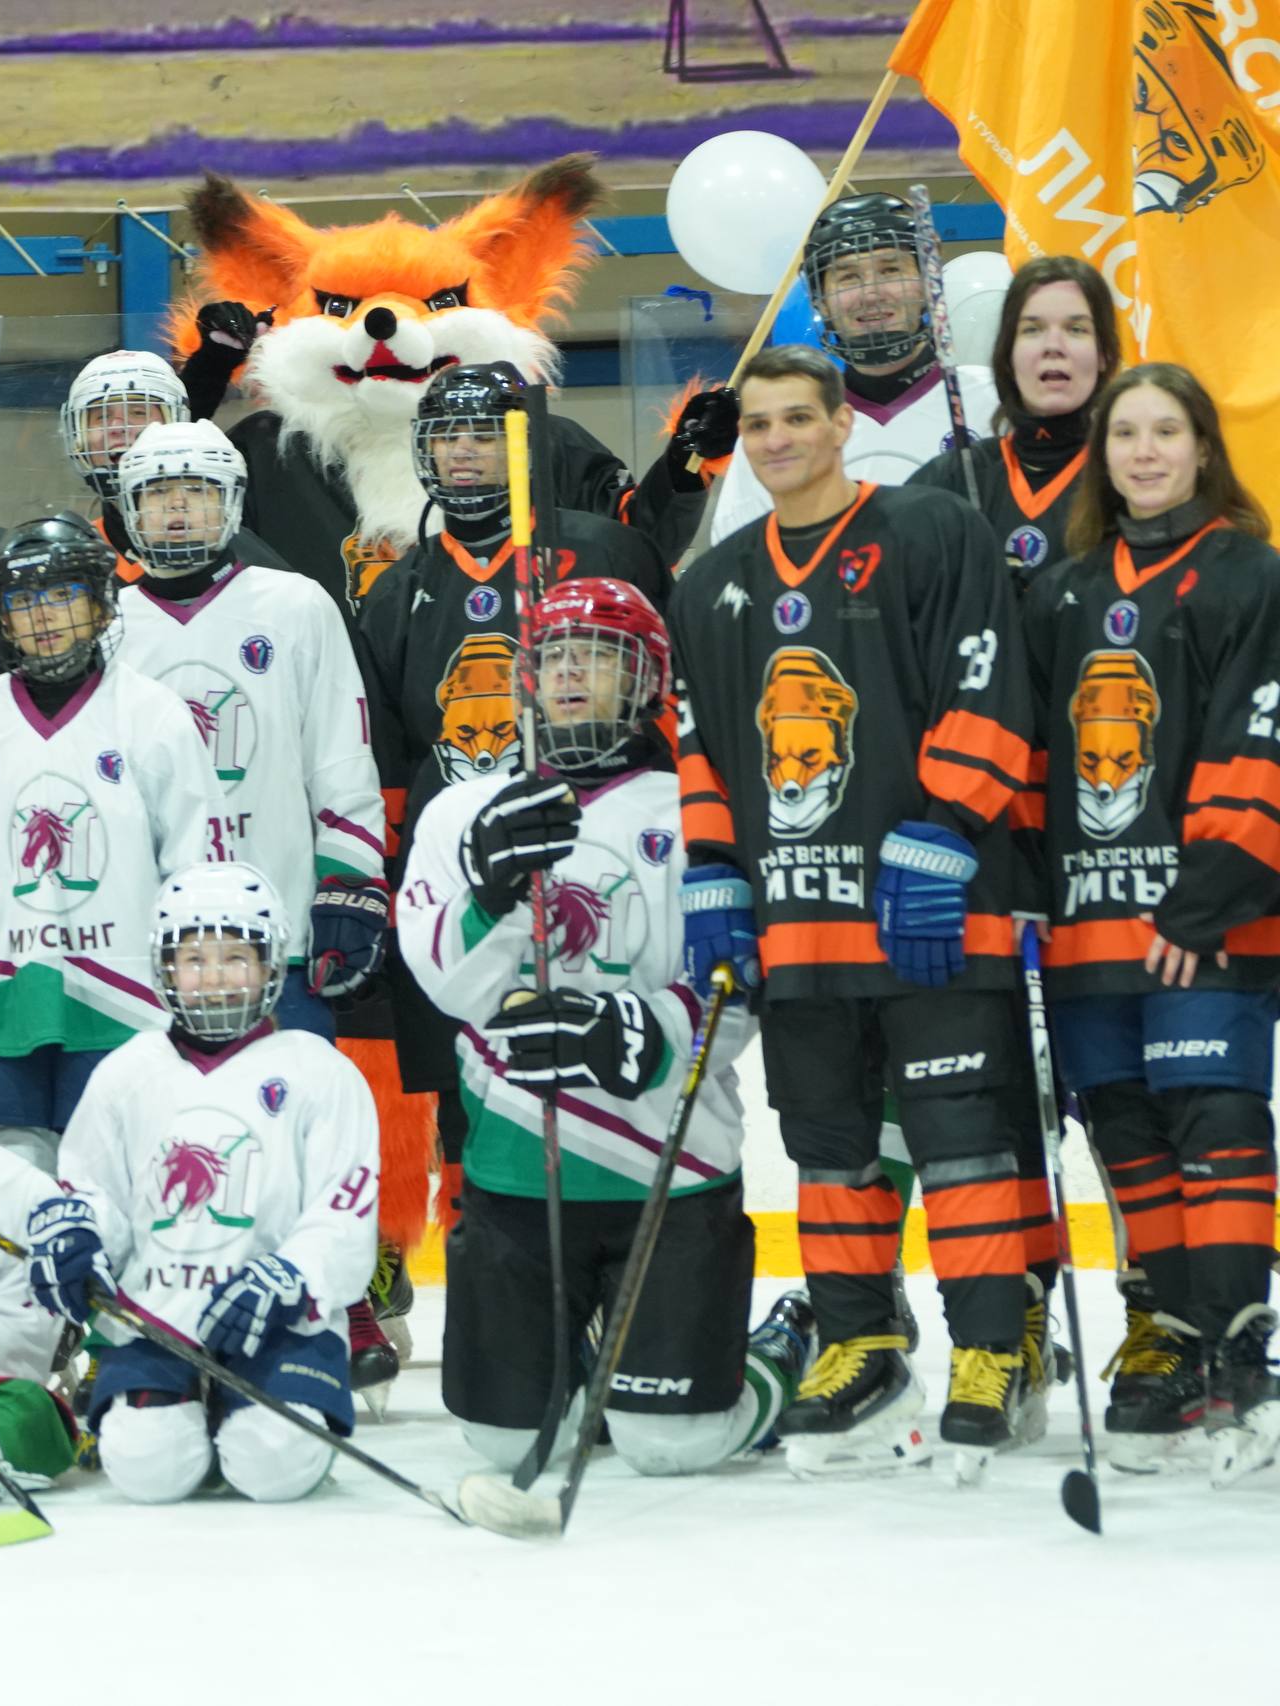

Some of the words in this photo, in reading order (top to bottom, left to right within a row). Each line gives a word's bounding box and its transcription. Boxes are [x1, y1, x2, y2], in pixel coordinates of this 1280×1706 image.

[445, 386, 490, 399] CCM
[904, 1051, 987, 1080] CCM
[610, 1372, 694, 1396] CCM
